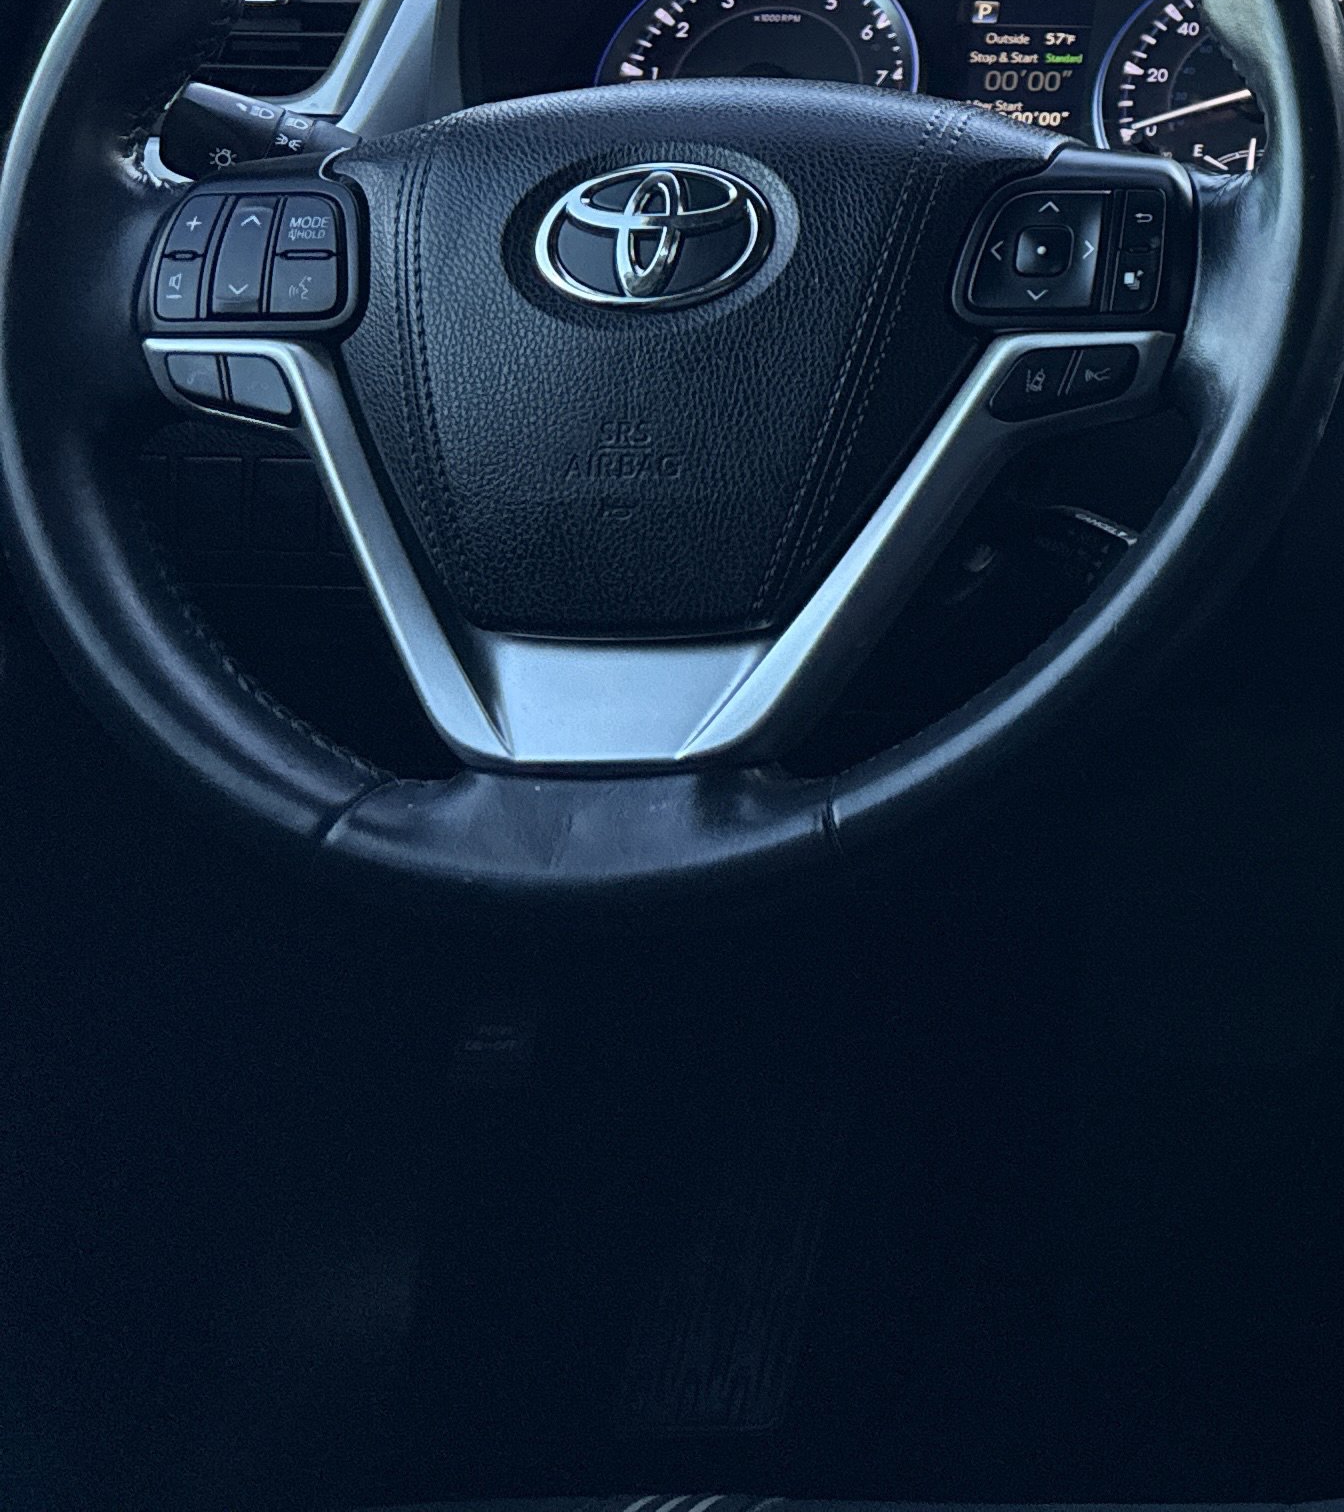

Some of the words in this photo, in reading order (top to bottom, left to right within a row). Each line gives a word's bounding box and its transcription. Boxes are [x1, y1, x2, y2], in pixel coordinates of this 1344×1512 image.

[977, 3, 993, 21] P
[675, 21, 690, 38] 2
[860, 24, 874, 40] 6
[1176, 21, 1200, 37] 40
[985, 31, 1031, 45] Outside
[968, 50, 998, 65] Stop
[998, 51, 1009, 64] &
[1009, 51, 1040, 64] Start
[1044, 52, 1084, 65] Standard
[875, 70, 889, 86] 7
[1145, 67, 1169, 84] 20
[994, 100, 1025, 112] Start
[1192, 143, 1205, 158] E
[289, 215, 331, 229] MODE
[600, 421, 651, 446] SRS
[565, 452, 682, 481] AIRBAG
